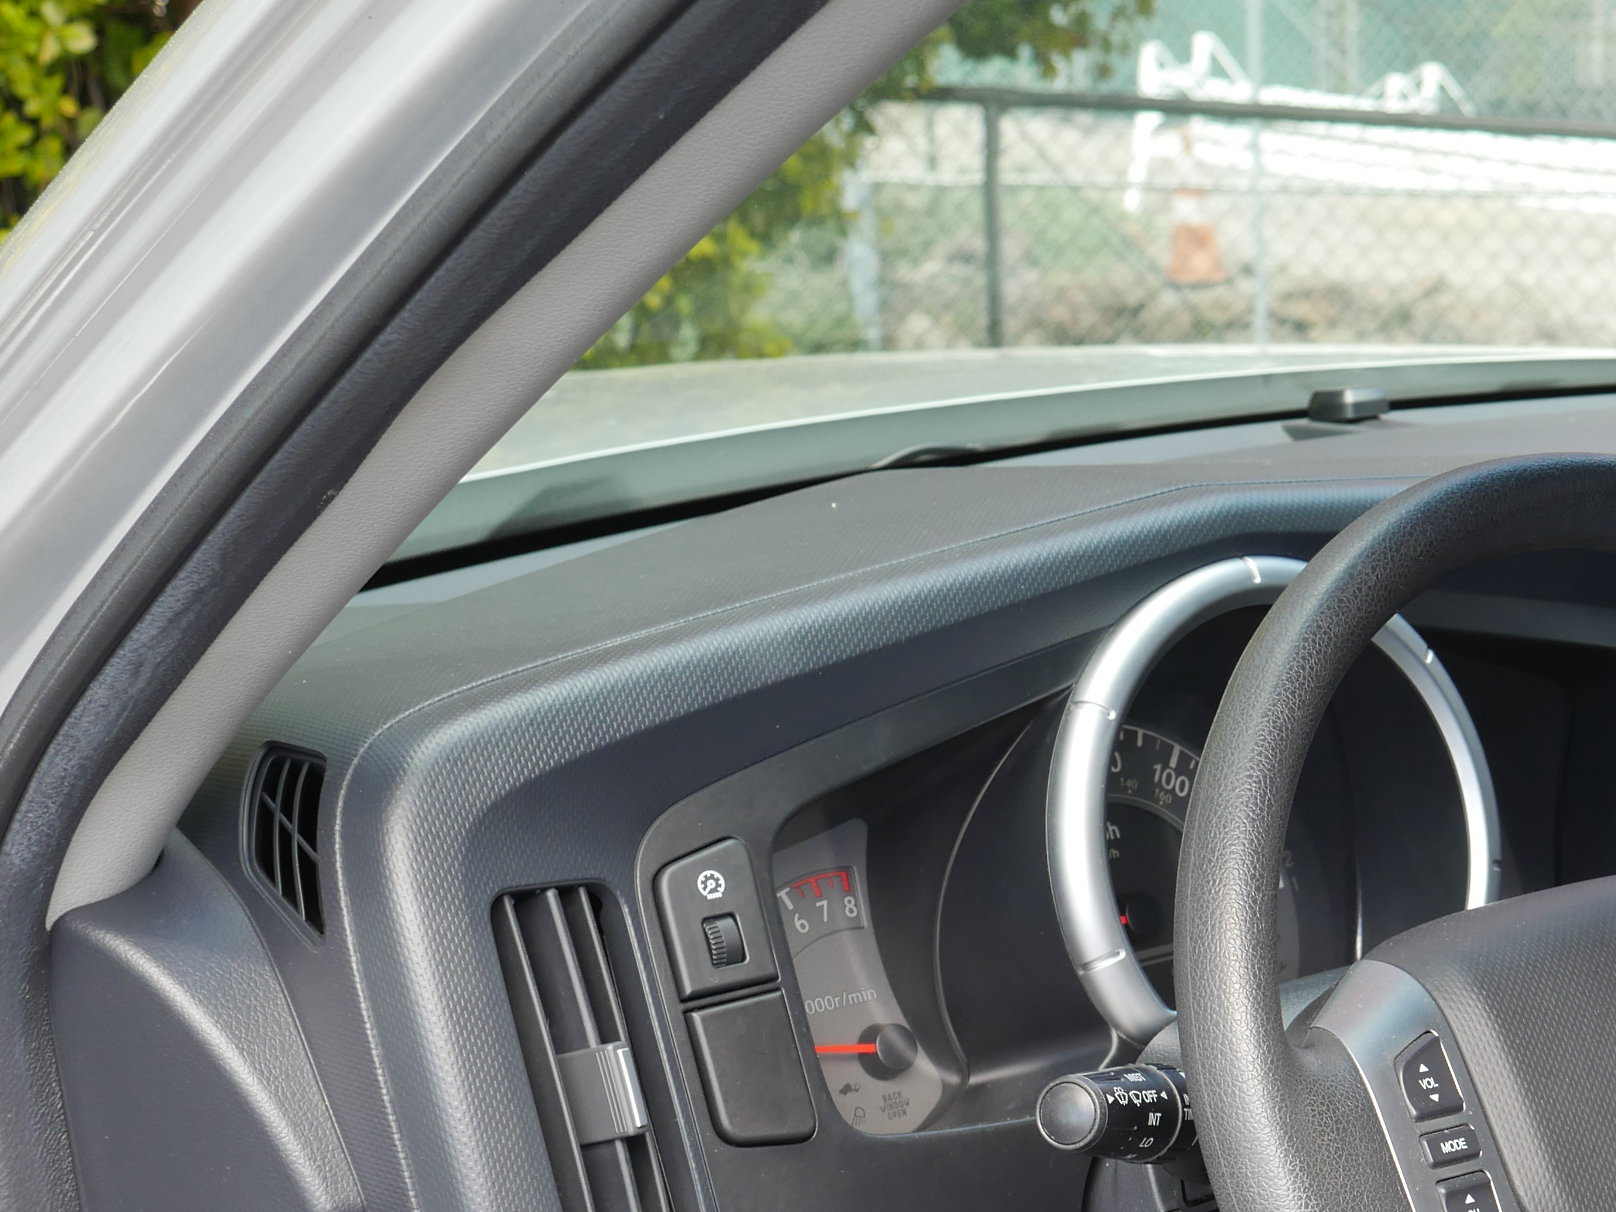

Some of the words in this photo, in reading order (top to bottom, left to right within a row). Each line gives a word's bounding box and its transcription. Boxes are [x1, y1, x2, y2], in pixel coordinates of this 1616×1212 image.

[1152, 763, 1190, 797] 100
[794, 913, 809, 933] 6
[815, 899, 829, 922] 7
[843, 896, 858, 918] 8
[804, 986, 878, 1015] 000r/min
[1418, 1077, 1440, 1090] VOL
[881, 1091, 903, 1103] BACK
[1142, 1089, 1158, 1103] OFF
[879, 1097, 910, 1113] WINDOW
[887, 1107, 908, 1121] OPEN
[1147, 1112, 1162, 1127] INT
[1138, 1137, 1154, 1148] LO
[1440, 1137, 1468, 1155] MODE
